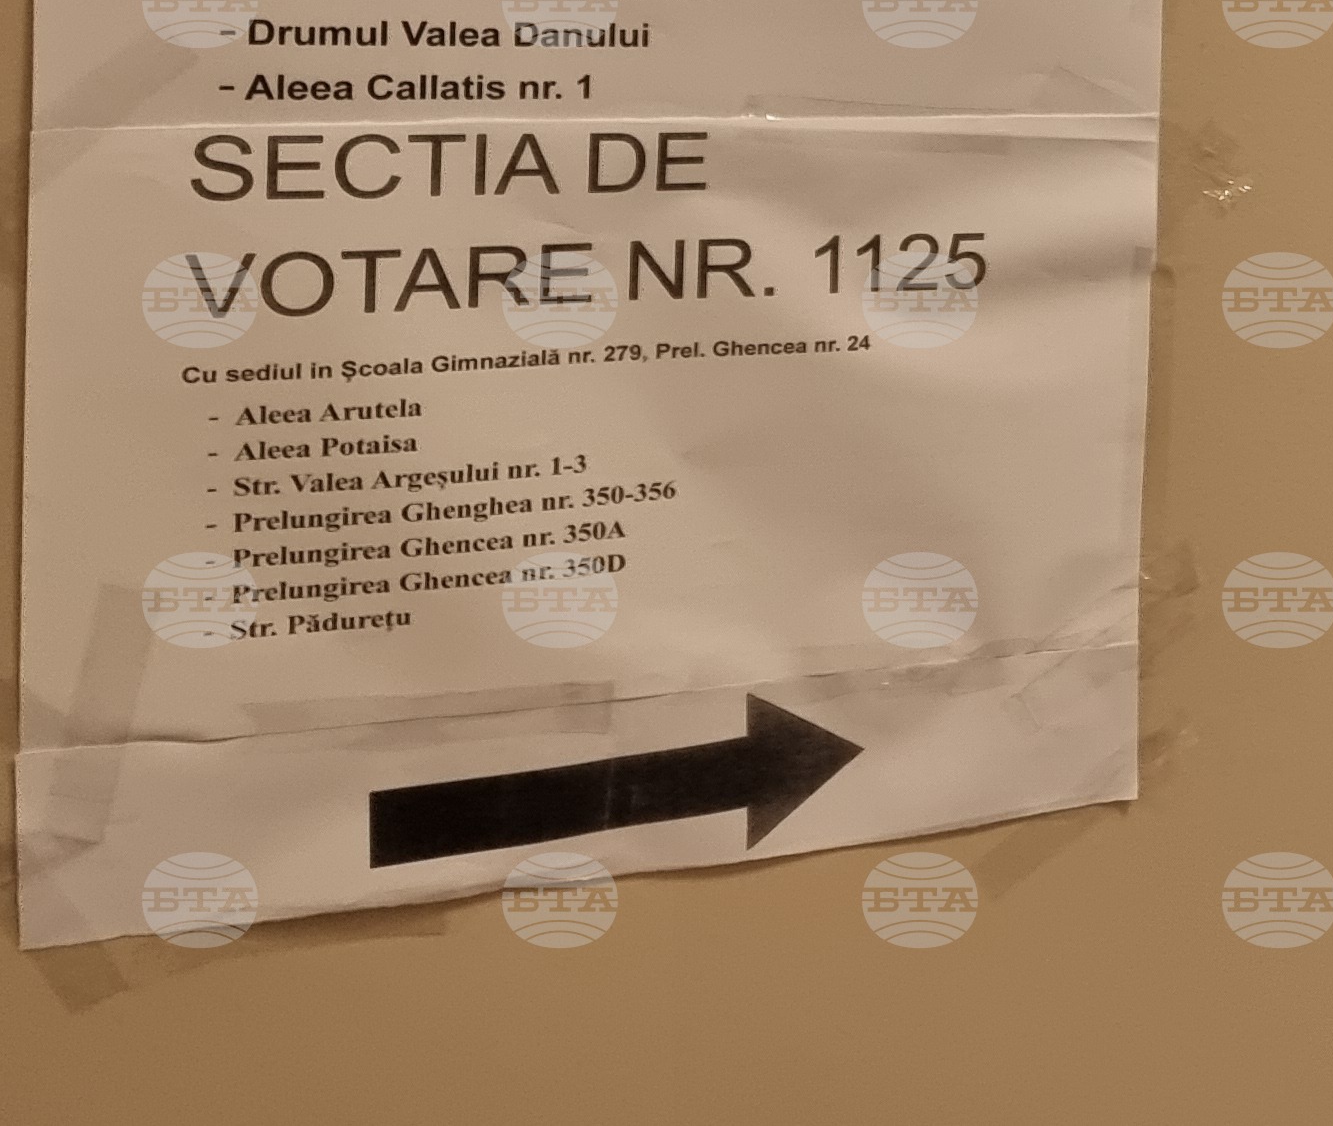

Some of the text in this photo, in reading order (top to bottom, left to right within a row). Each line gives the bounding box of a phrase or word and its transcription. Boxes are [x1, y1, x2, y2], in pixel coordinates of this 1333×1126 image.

[248, 19, 649, 47] Drumul Valea Danului
[245, 74, 590, 100] Aleea Callatis nr. 1
[191, 132, 708, 201] SECTIA DE
[185, 233, 986, 318] VOTARE NR. 1125
[182, 366, 217, 384] Cu
[225, 363, 302, 382] sediul
[311, 362, 332, 379] in
[431, 349, 560, 372] Gimnazială
[568, 351, 596, 364] nr.
[603, 344, 648, 362] 279,
[656, 342, 706, 359] Prel.
[712, 340, 807, 357] Ghencea
[814, 340, 840, 353] nr.
[847, 335, 871, 351] 24
[235, 399, 422, 425] Aleea Arutela
[234, 435, 417, 461] Aleea Potaisa
[234, 477, 280, 496] Str.
[291, 473, 363, 493] Valea
[508, 464, 540, 479] nr.
[552, 454, 587, 475] 1-3
[235, 481, 677, 532] Prelungirea Ghenghea nr. 350-356
[233, 521, 625, 568] Prelungirea Ghencea nr. 350A
[233, 554, 626, 604] Prelungirea Ghencea nr. 350D
[230, 621, 277, 639] Str.
